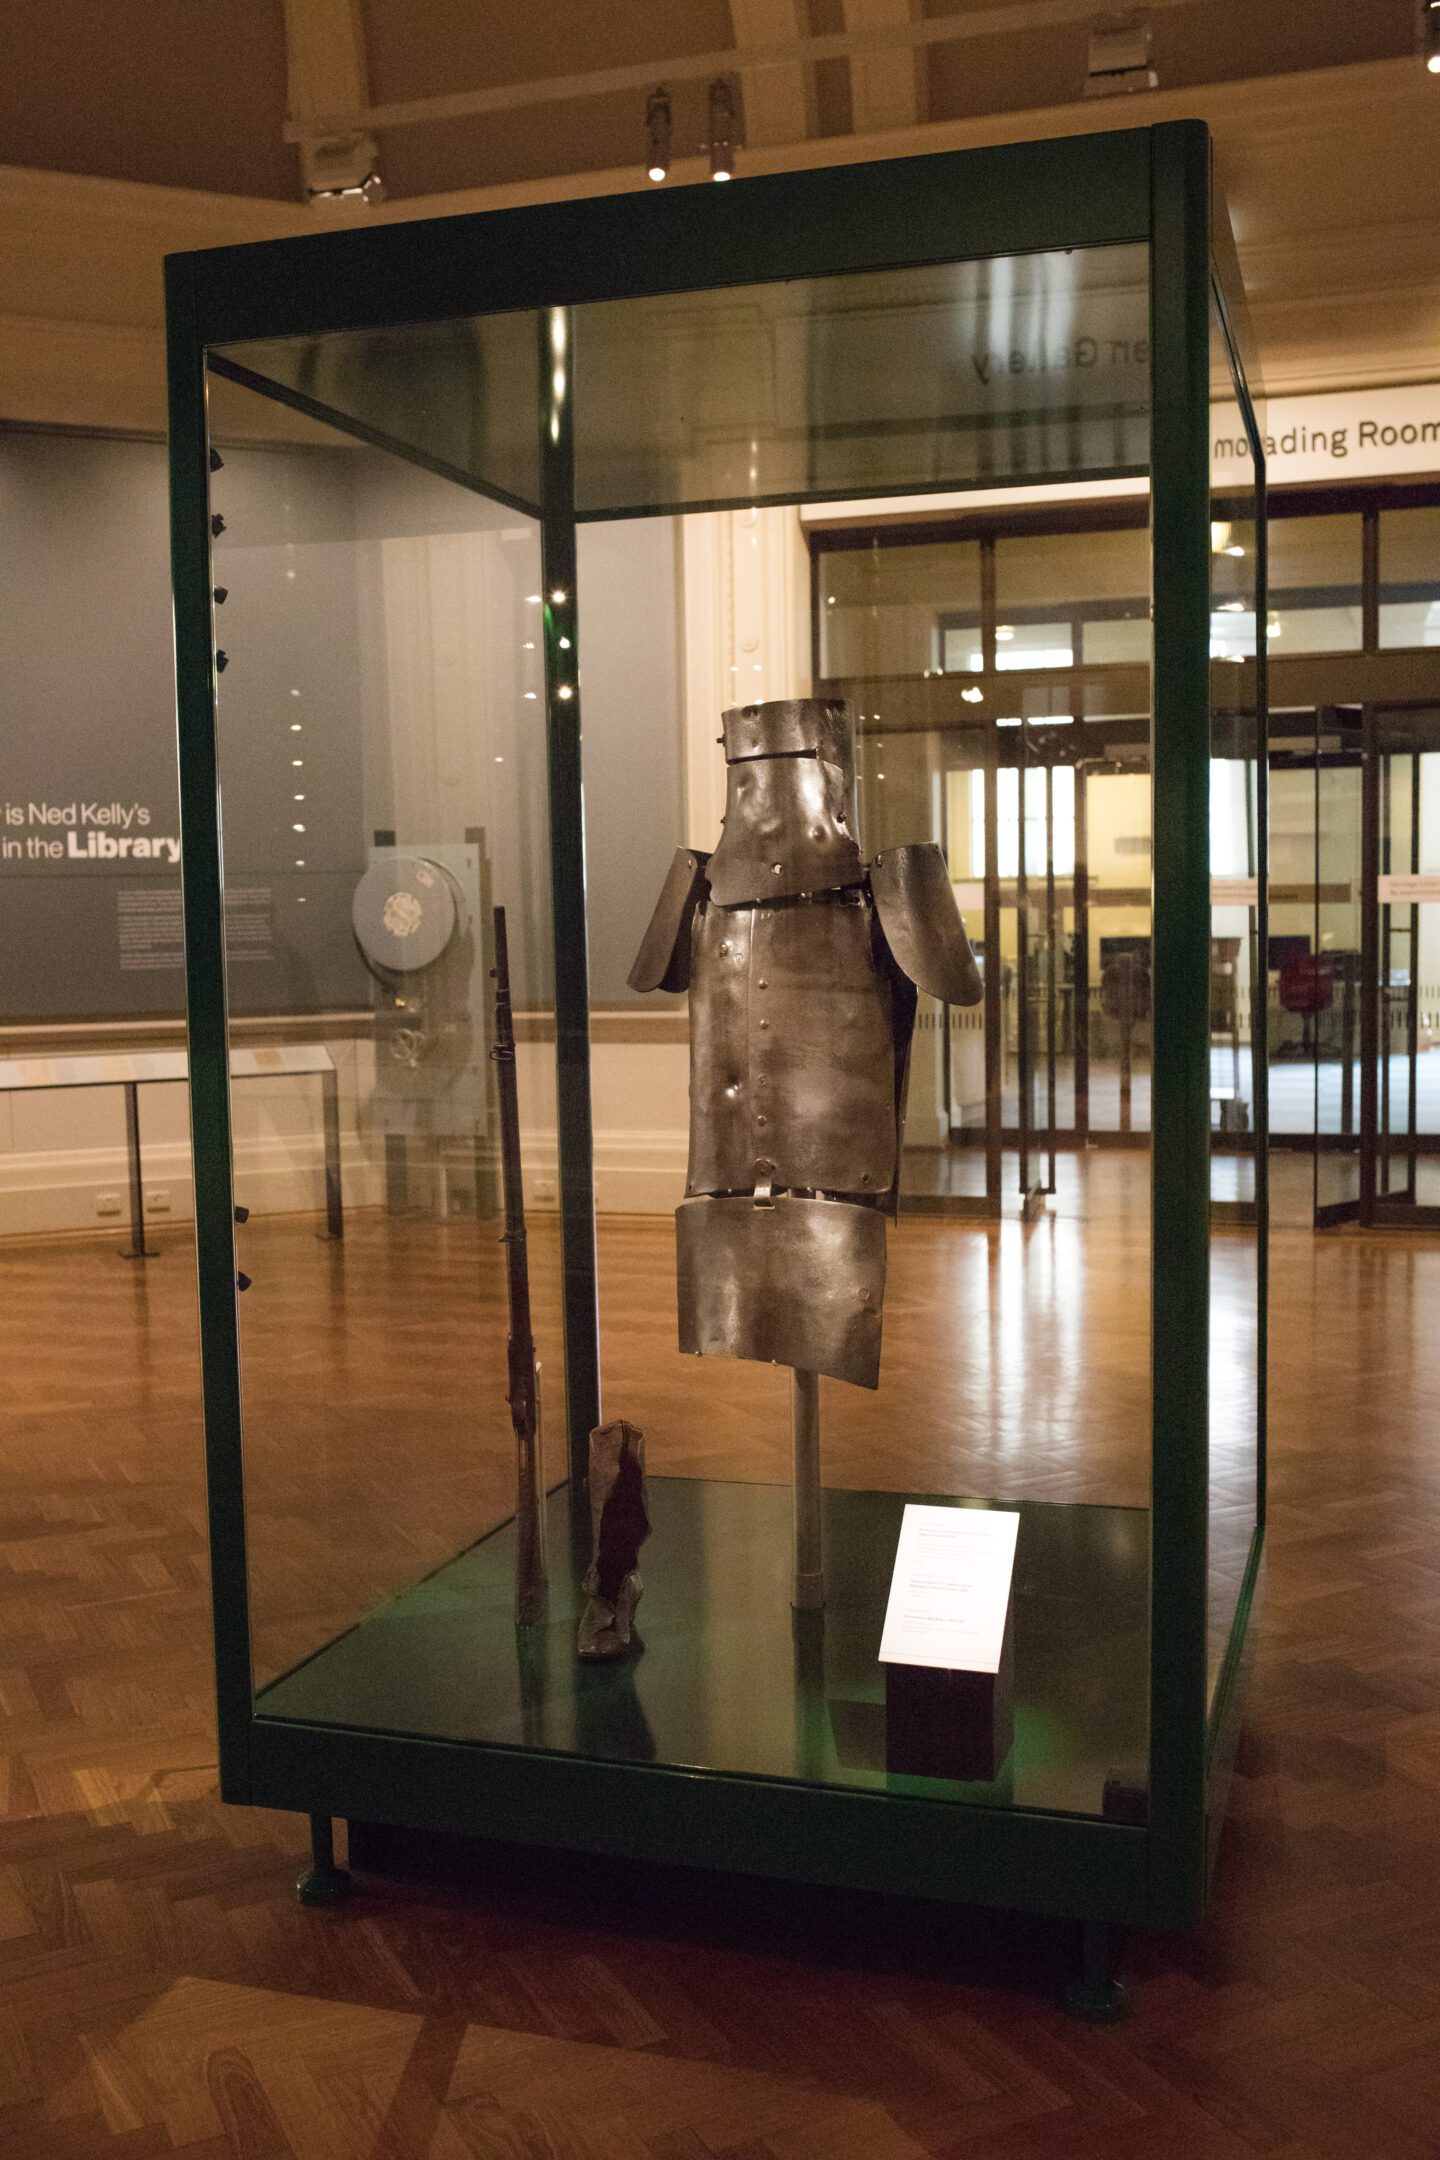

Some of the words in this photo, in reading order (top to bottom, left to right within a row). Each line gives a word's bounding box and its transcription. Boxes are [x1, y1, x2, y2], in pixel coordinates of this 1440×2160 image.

[1264, 426, 1348, 458] ading
[5, 802, 24, 826] is
[28, 802, 77, 826] Ned
[81, 802, 151, 829] Kelly's
[2, 836, 22, 859] in
[26, 836, 63, 859] the
[67, 830, 180, 863] Library
